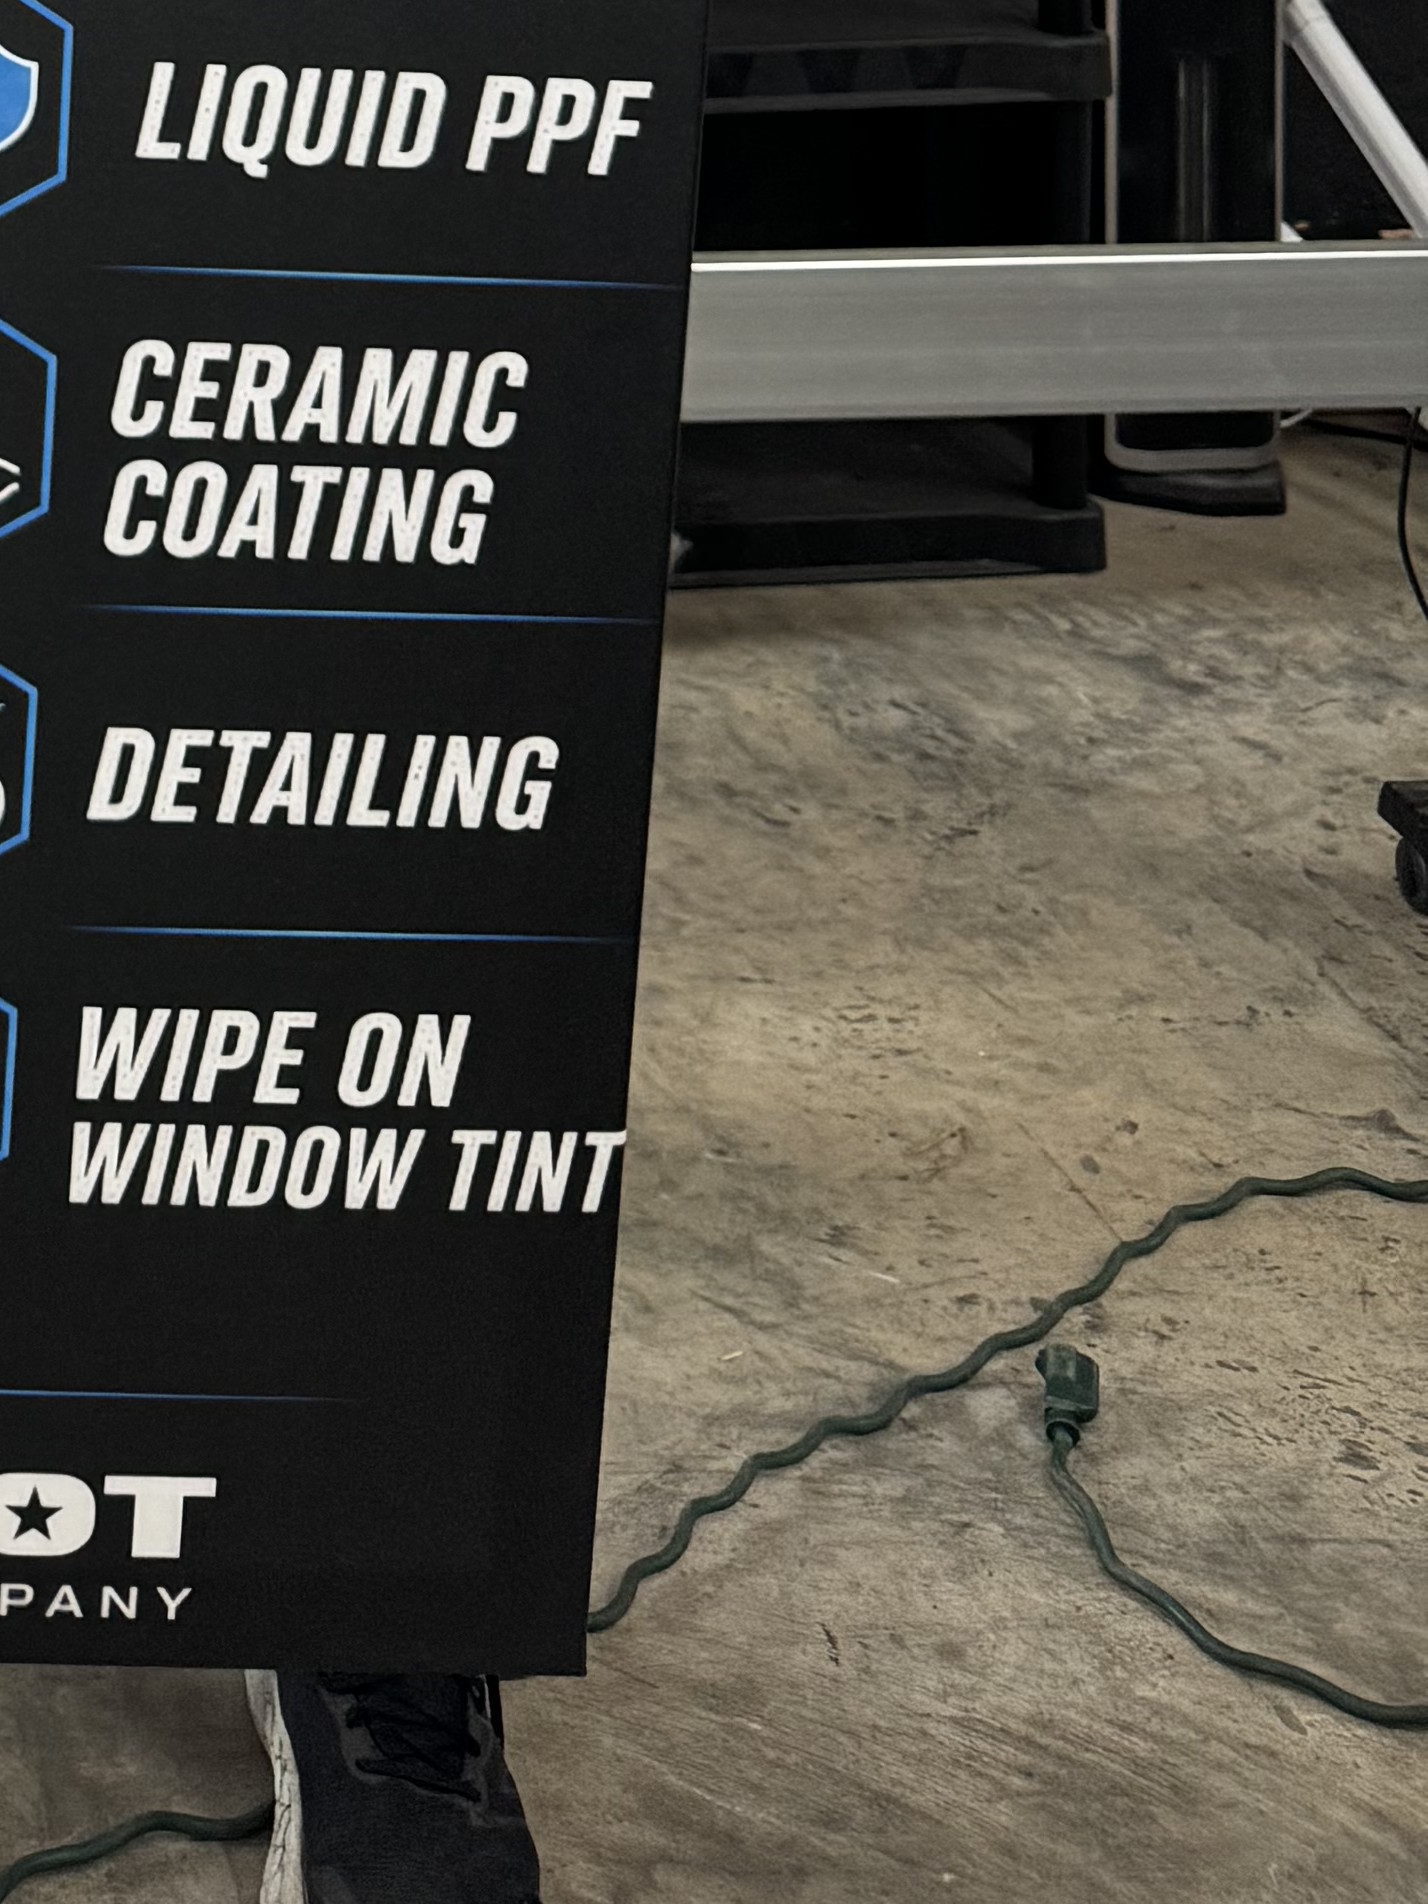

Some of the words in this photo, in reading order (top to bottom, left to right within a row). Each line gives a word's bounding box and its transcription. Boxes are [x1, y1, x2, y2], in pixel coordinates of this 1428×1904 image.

[134, 61, 448, 179] LIQUID
[464, 73, 654, 177] PPF
[109, 338, 529, 449] CERAMIC
[101, 459, 496, 566] COATING
[84, 726, 561, 832] DETAILING
[74, 1004, 318, 1107] WIPE
[335, 1011, 472, 1107] ON
[67, 1119, 426, 1211] WINDOW
[448, 1127, 628, 1214] TINT
